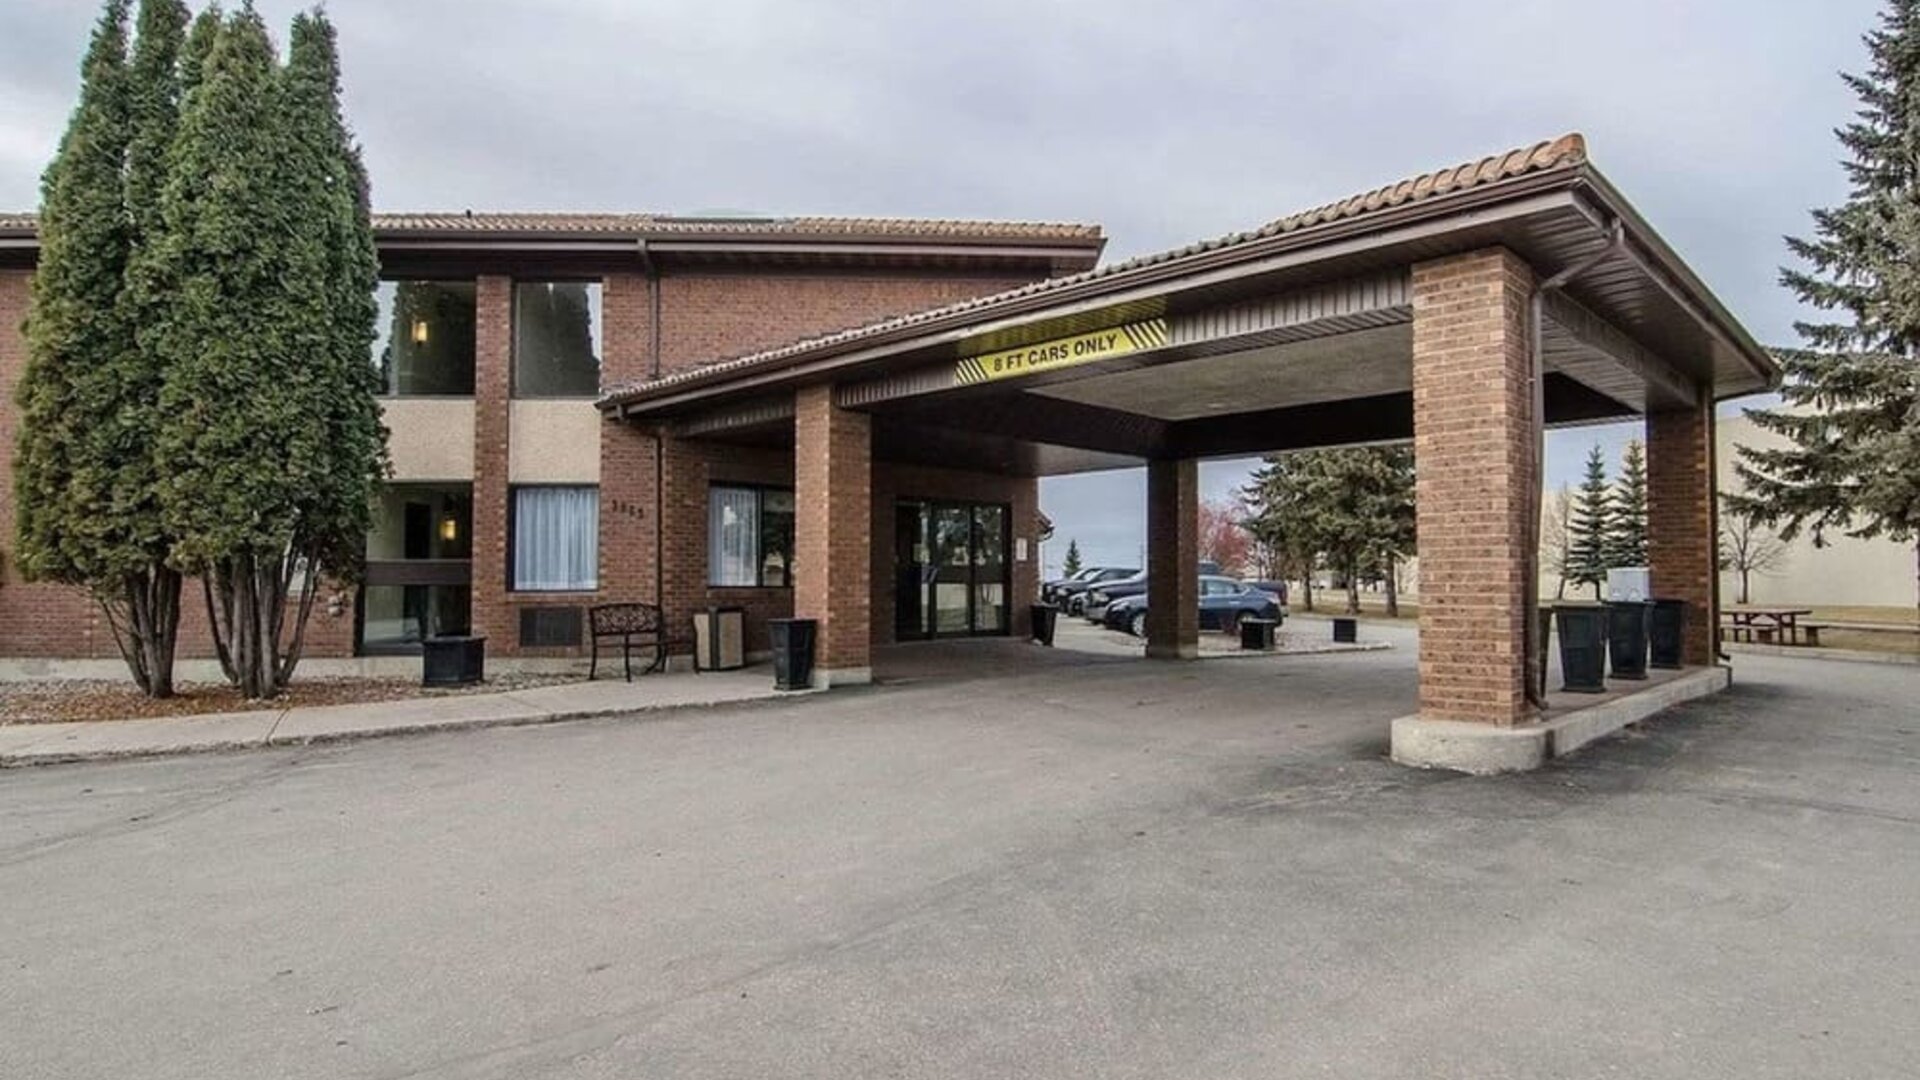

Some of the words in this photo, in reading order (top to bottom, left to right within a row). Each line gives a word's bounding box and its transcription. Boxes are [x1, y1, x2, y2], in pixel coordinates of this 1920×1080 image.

[994, 358, 1003, 372] 8
[1007, 353, 1024, 370] FT
[1028, 344, 1069, 365] CARS
[1074, 334, 1117, 356] ONLY
